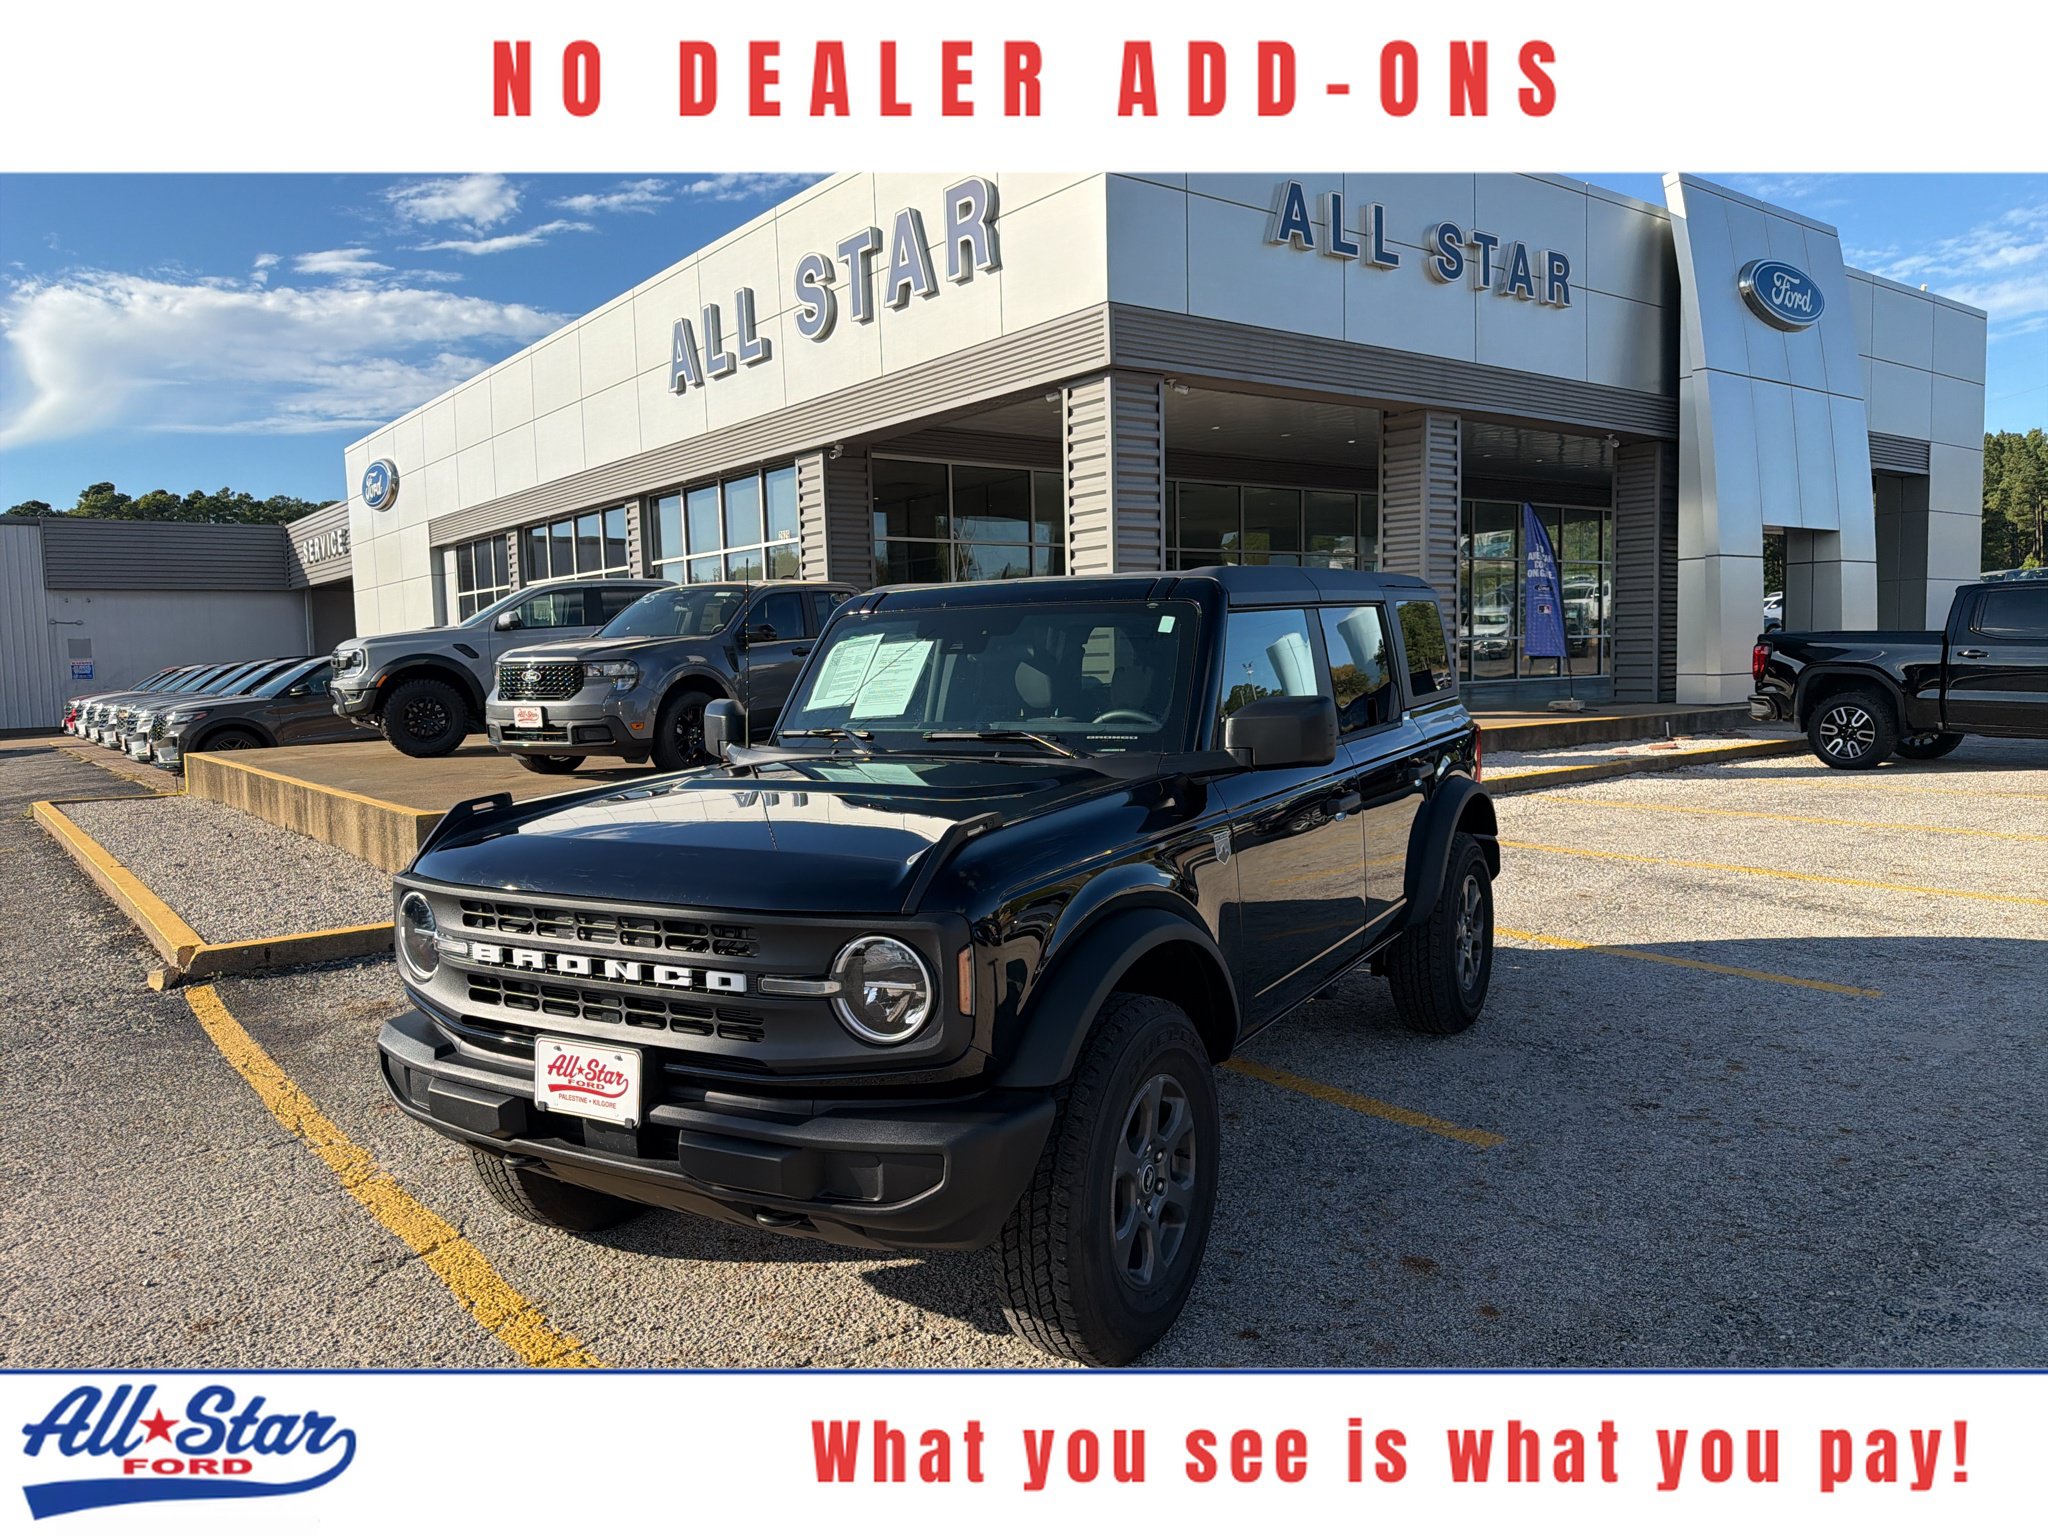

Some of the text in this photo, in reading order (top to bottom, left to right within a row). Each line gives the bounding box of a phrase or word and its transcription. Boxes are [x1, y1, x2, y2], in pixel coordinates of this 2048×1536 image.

[1271, 179, 1573, 308] ALL STAR
[668, 175, 1002, 395] ALL STAR
[1771, 271, 1813, 313] Ford
[365, 470, 383, 500] Ford
[302, 529, 344, 563] SERVICE
[471, 941, 748, 993] BRONCO
[547, 1054, 625, 1086] All Star
[567, 1078, 606, 1091] FORD
[558, 1092, 617, 1110] PALESTINE KILGORE
